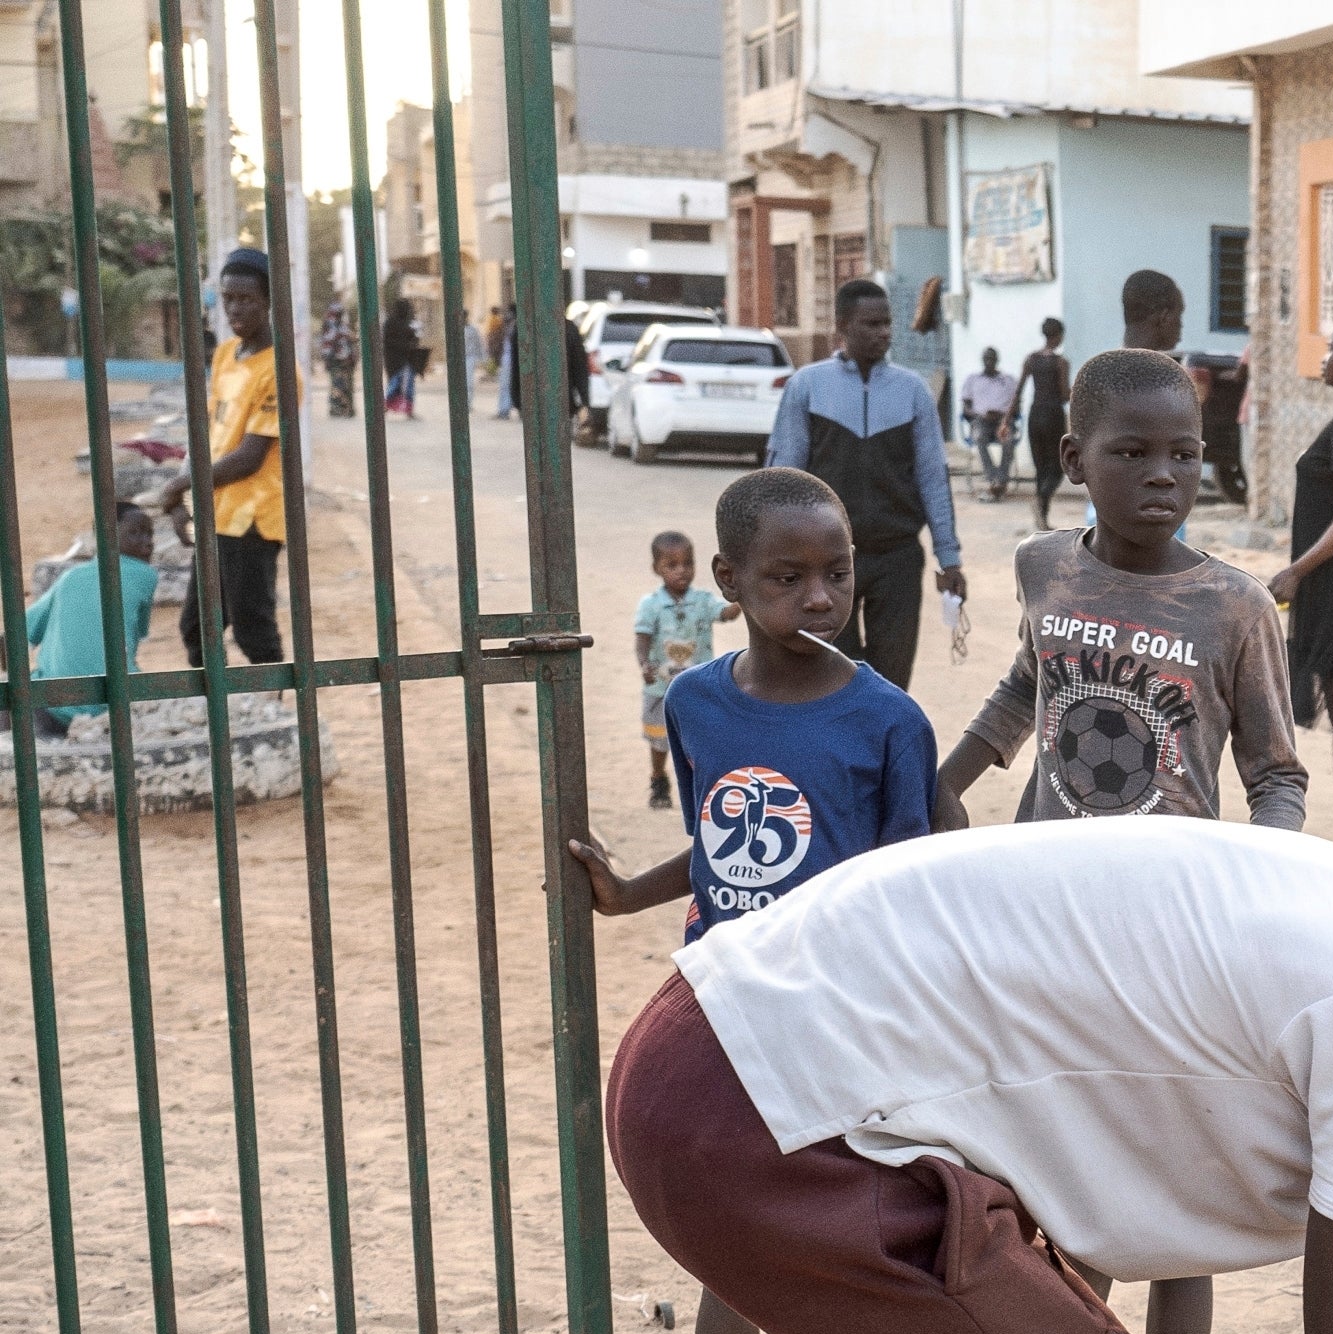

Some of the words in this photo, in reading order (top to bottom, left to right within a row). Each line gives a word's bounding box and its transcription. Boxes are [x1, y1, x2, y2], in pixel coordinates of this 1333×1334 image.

[1040, 614, 1117, 650] SUPER
[1131, 630, 1199, 667] GOAL
[1080, 649, 1160, 699] KICK
[1049, 771, 1078, 816] WELCOME
[709, 785, 801, 868] 95
[728, 863, 764, 880] ans
[708, 884, 782, 912] SOBO
